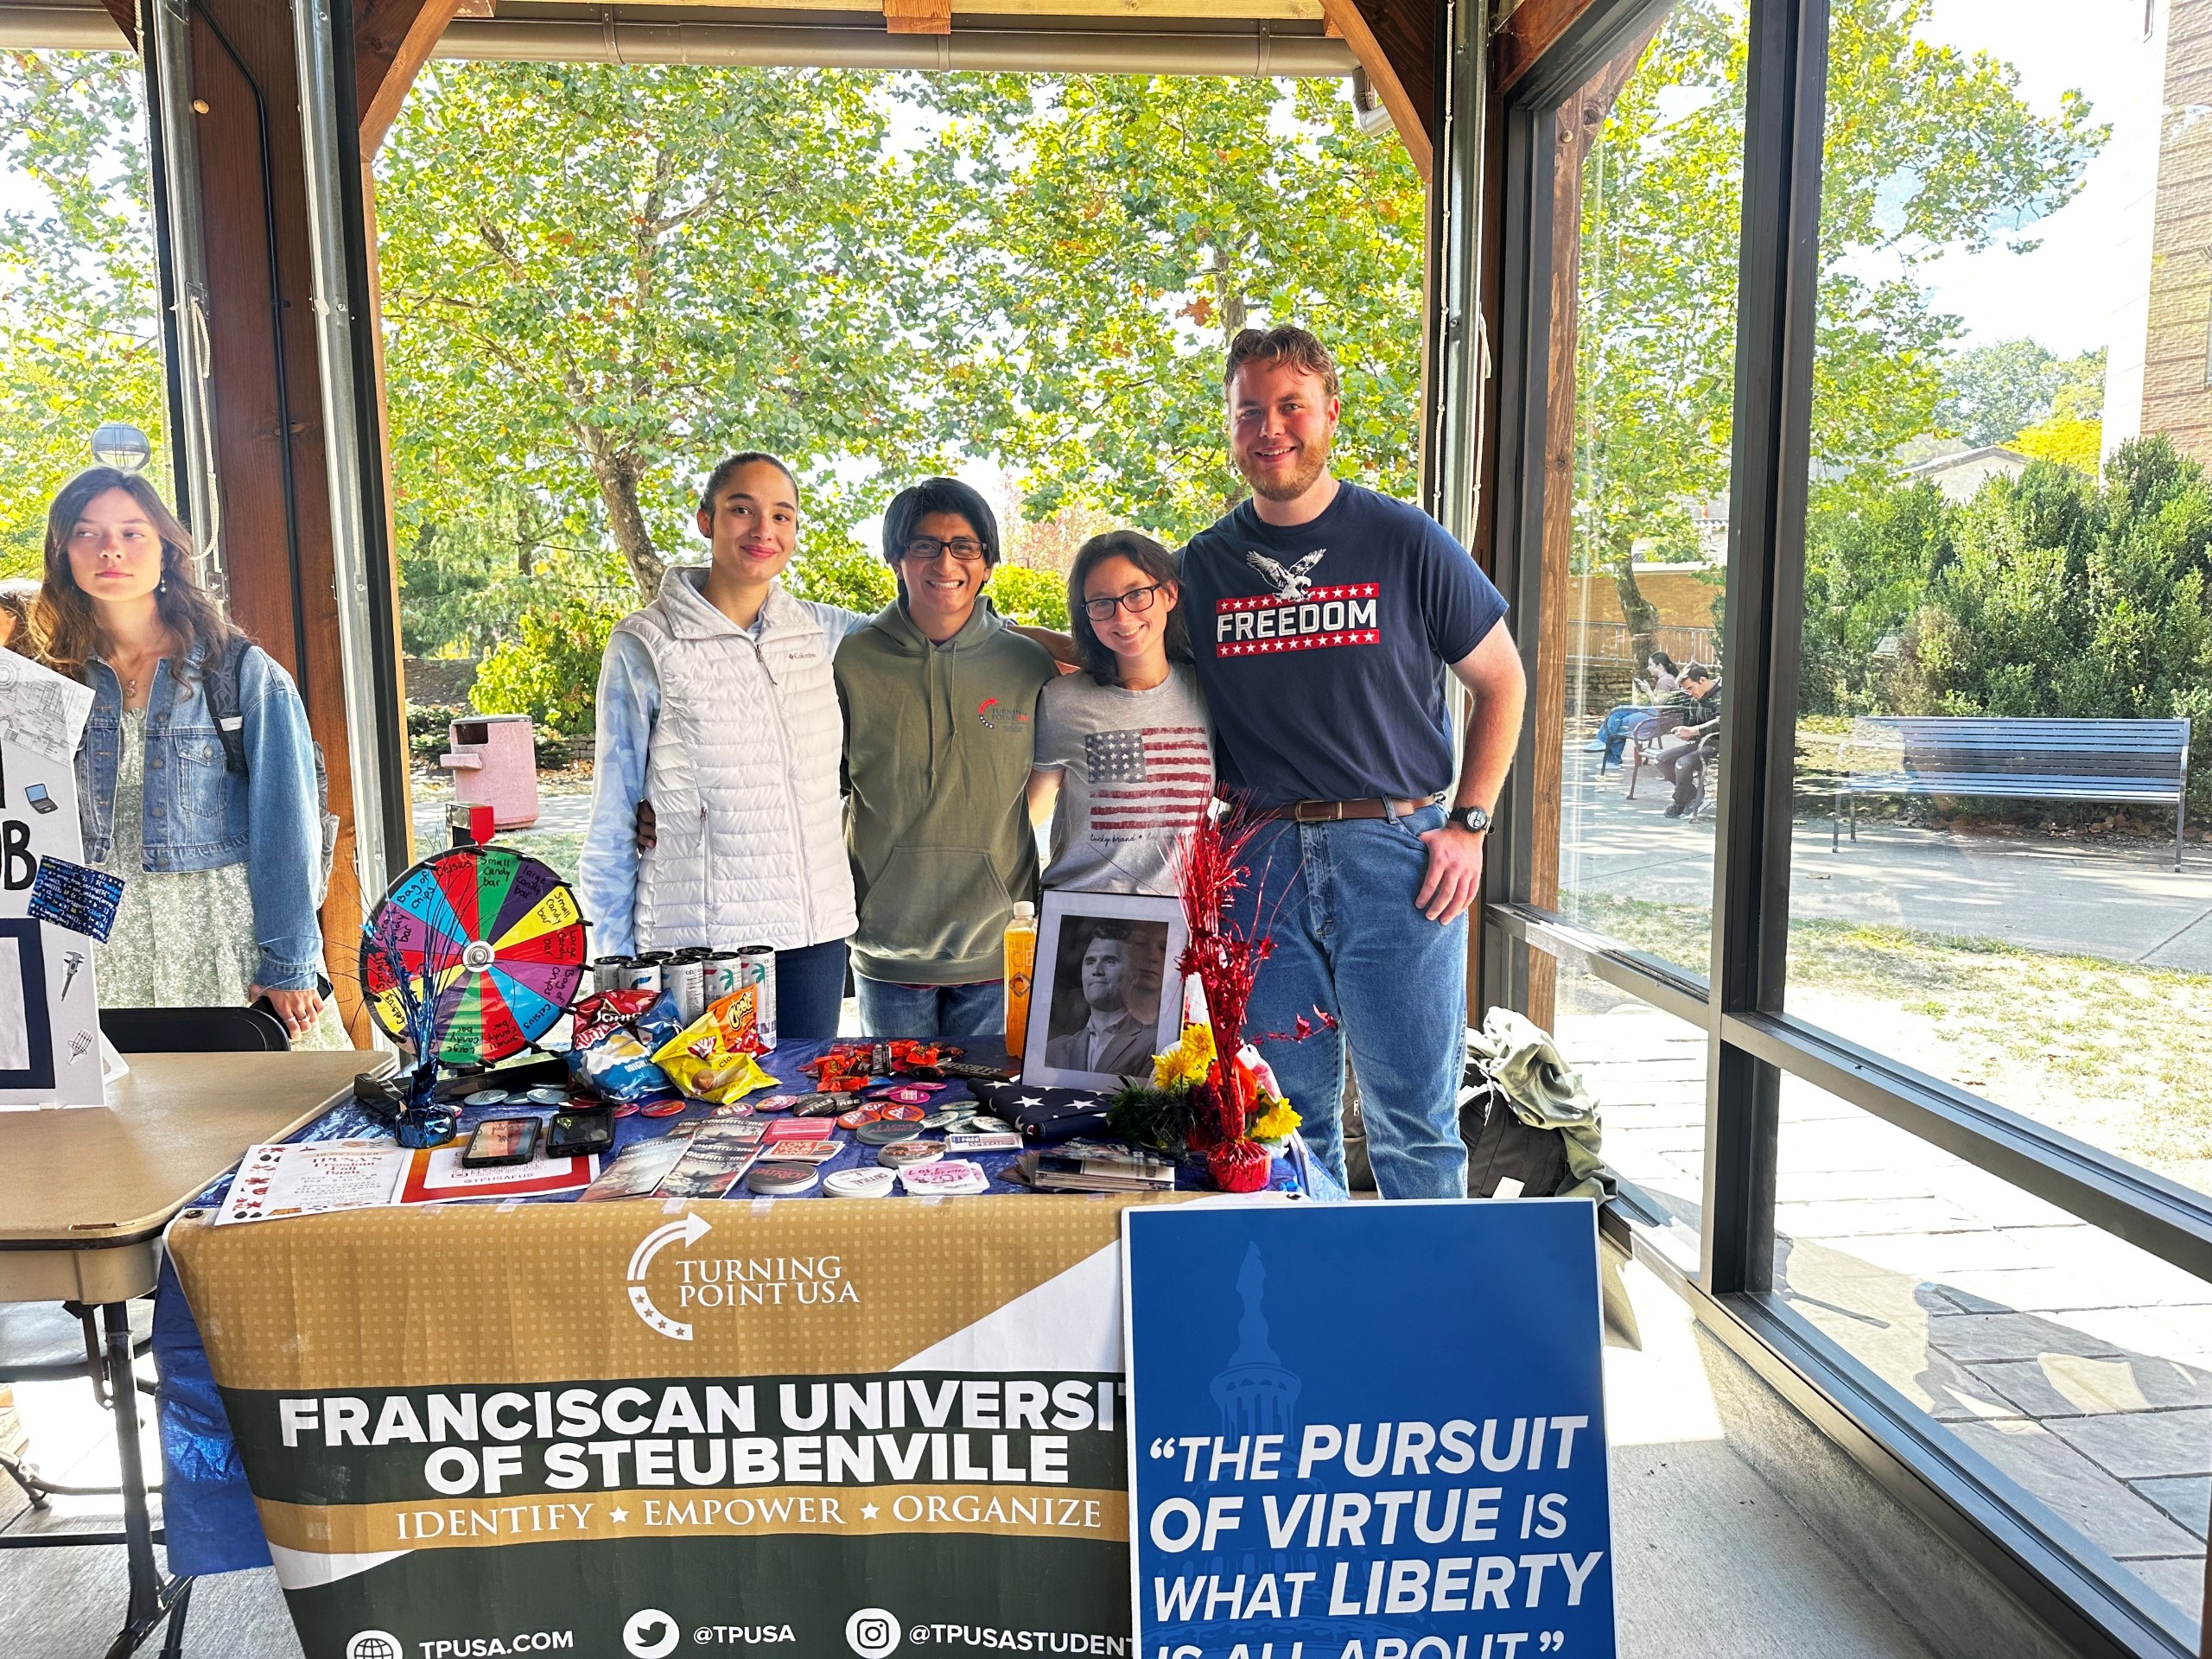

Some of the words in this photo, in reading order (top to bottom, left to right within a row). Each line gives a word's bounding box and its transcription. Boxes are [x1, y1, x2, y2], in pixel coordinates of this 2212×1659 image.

[1217, 599, 1377, 643] FREEDOM
[480, 855, 511, 868] Small
[396, 884, 423, 904] Bag
[419, 870, 430, 884] of
[483, 876, 501, 887] bar
[513, 886, 532, 899] bar
[537, 906, 551, 925] bar
[554, 892, 571, 918] Small
[543, 937, 554, 957] bar
[555, 969, 575, 990] Bag
[522, 1002, 552, 1030] Celsius
[463, 1173, 534, 1184] @TPUSAFUS
[752, 1167, 810, 1180] PATRIOT
[676, 1255, 842, 1283] TURNING
[678, 1282, 787, 1307] POINT
[795, 1281, 861, 1305] USA
[279, 1384, 755, 1447] FRANCISCAN
[779, 1379, 1126, 1432] UNIVERSI
[1150, 1434, 1284, 1482] “THE
[1296, 1414, 1589, 1478] PURSUIT
[424, 1445, 522, 1495] OF
[544, 1433, 1069, 1491] STEUBENVILLE
[396, 1503, 595, 1541] IDENTIFY
[642, 1495, 848, 1527] EMPOWER
[893, 1495, 1102, 1528] ORGANIZE
[1149, 1497, 1244, 1553] OF
[1262, 1487, 1503, 1549] VIRTUE
[1519, 1493, 1568, 1539] IS
[1154, 1572, 1317, 1623] WHAT
[1328, 1552, 1604, 1616] LIBERTY
[419, 1630, 574, 1659] TPUSA.COM
[693, 1624, 797, 1645] @TPUSA
